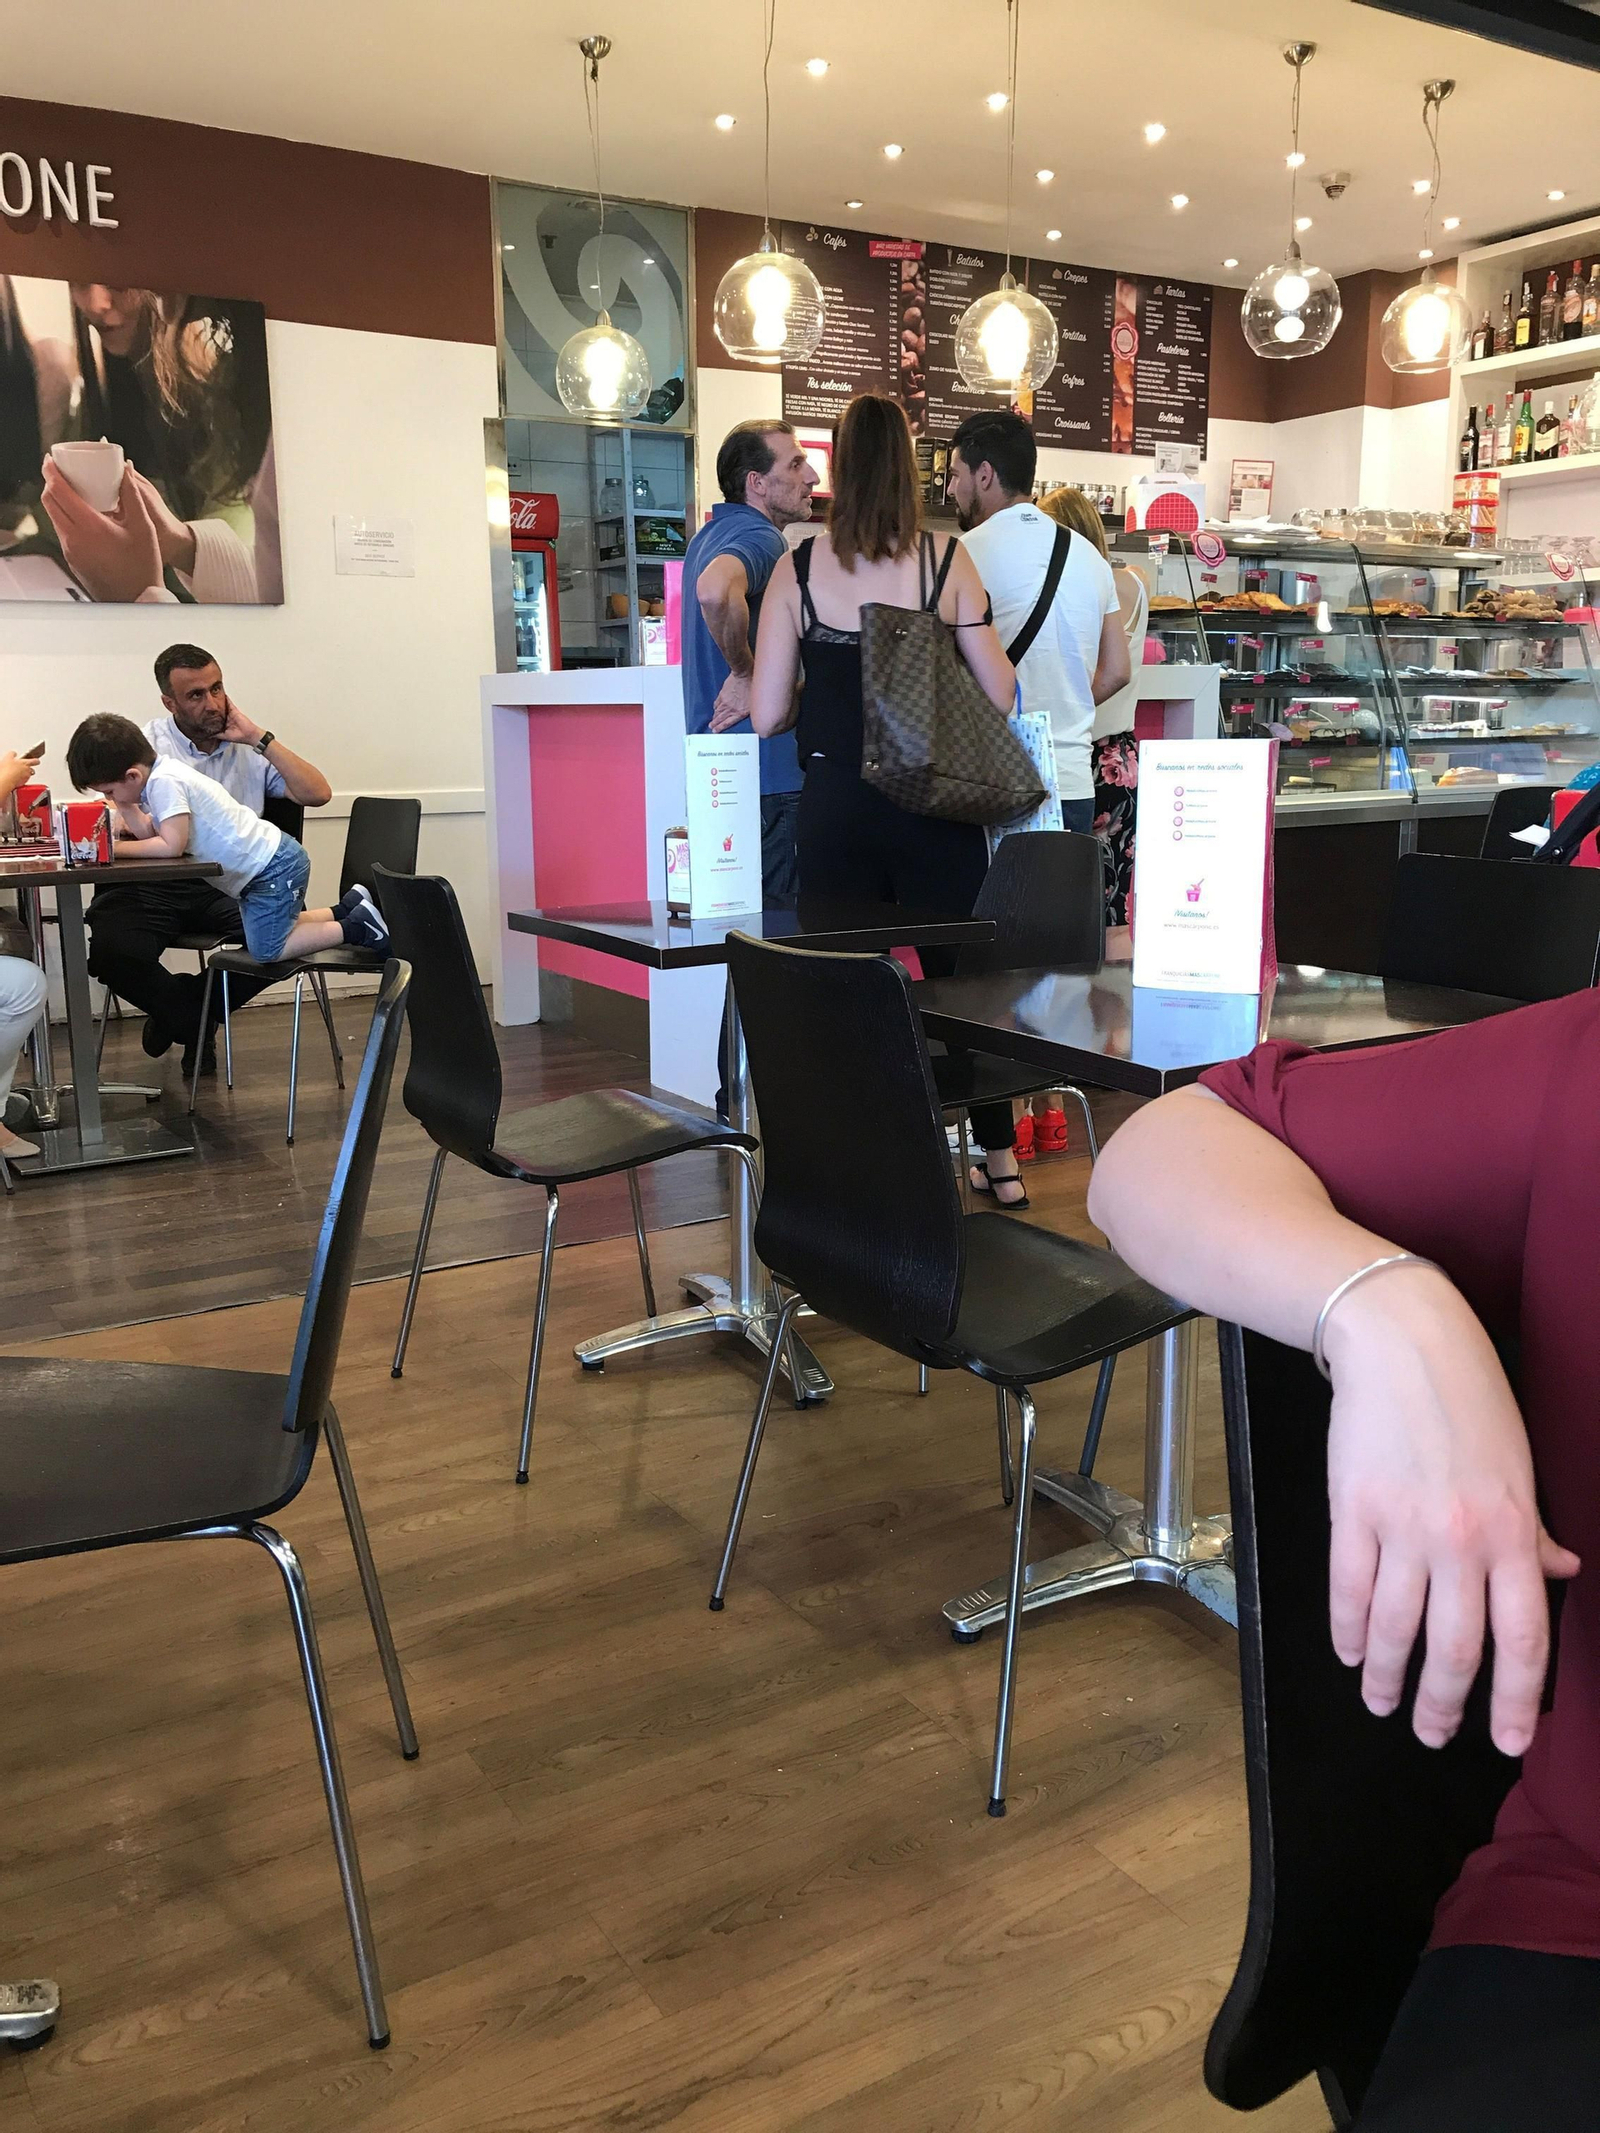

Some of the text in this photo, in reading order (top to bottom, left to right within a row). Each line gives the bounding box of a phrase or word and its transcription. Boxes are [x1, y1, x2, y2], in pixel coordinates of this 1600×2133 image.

[0, 152, 119, 228] ONE
[823, 233, 847, 250] Cafés
[956, 253, 984, 268] Batidos
[1063, 270, 1088, 285] Crepes
[1062, 329, 1087, 342] Tortitas
[1156, 342, 1190, 356] Pastelería
[807, 376, 820, 390] Tés
[1062, 374, 1086, 389] Gofres
[1054, 417, 1091, 430] Croissants
[1158, 411, 1185, 424] Bollería
[511, 498, 540, 529] ola
[354, 530, 395, 539] AUTOSERVICIO
